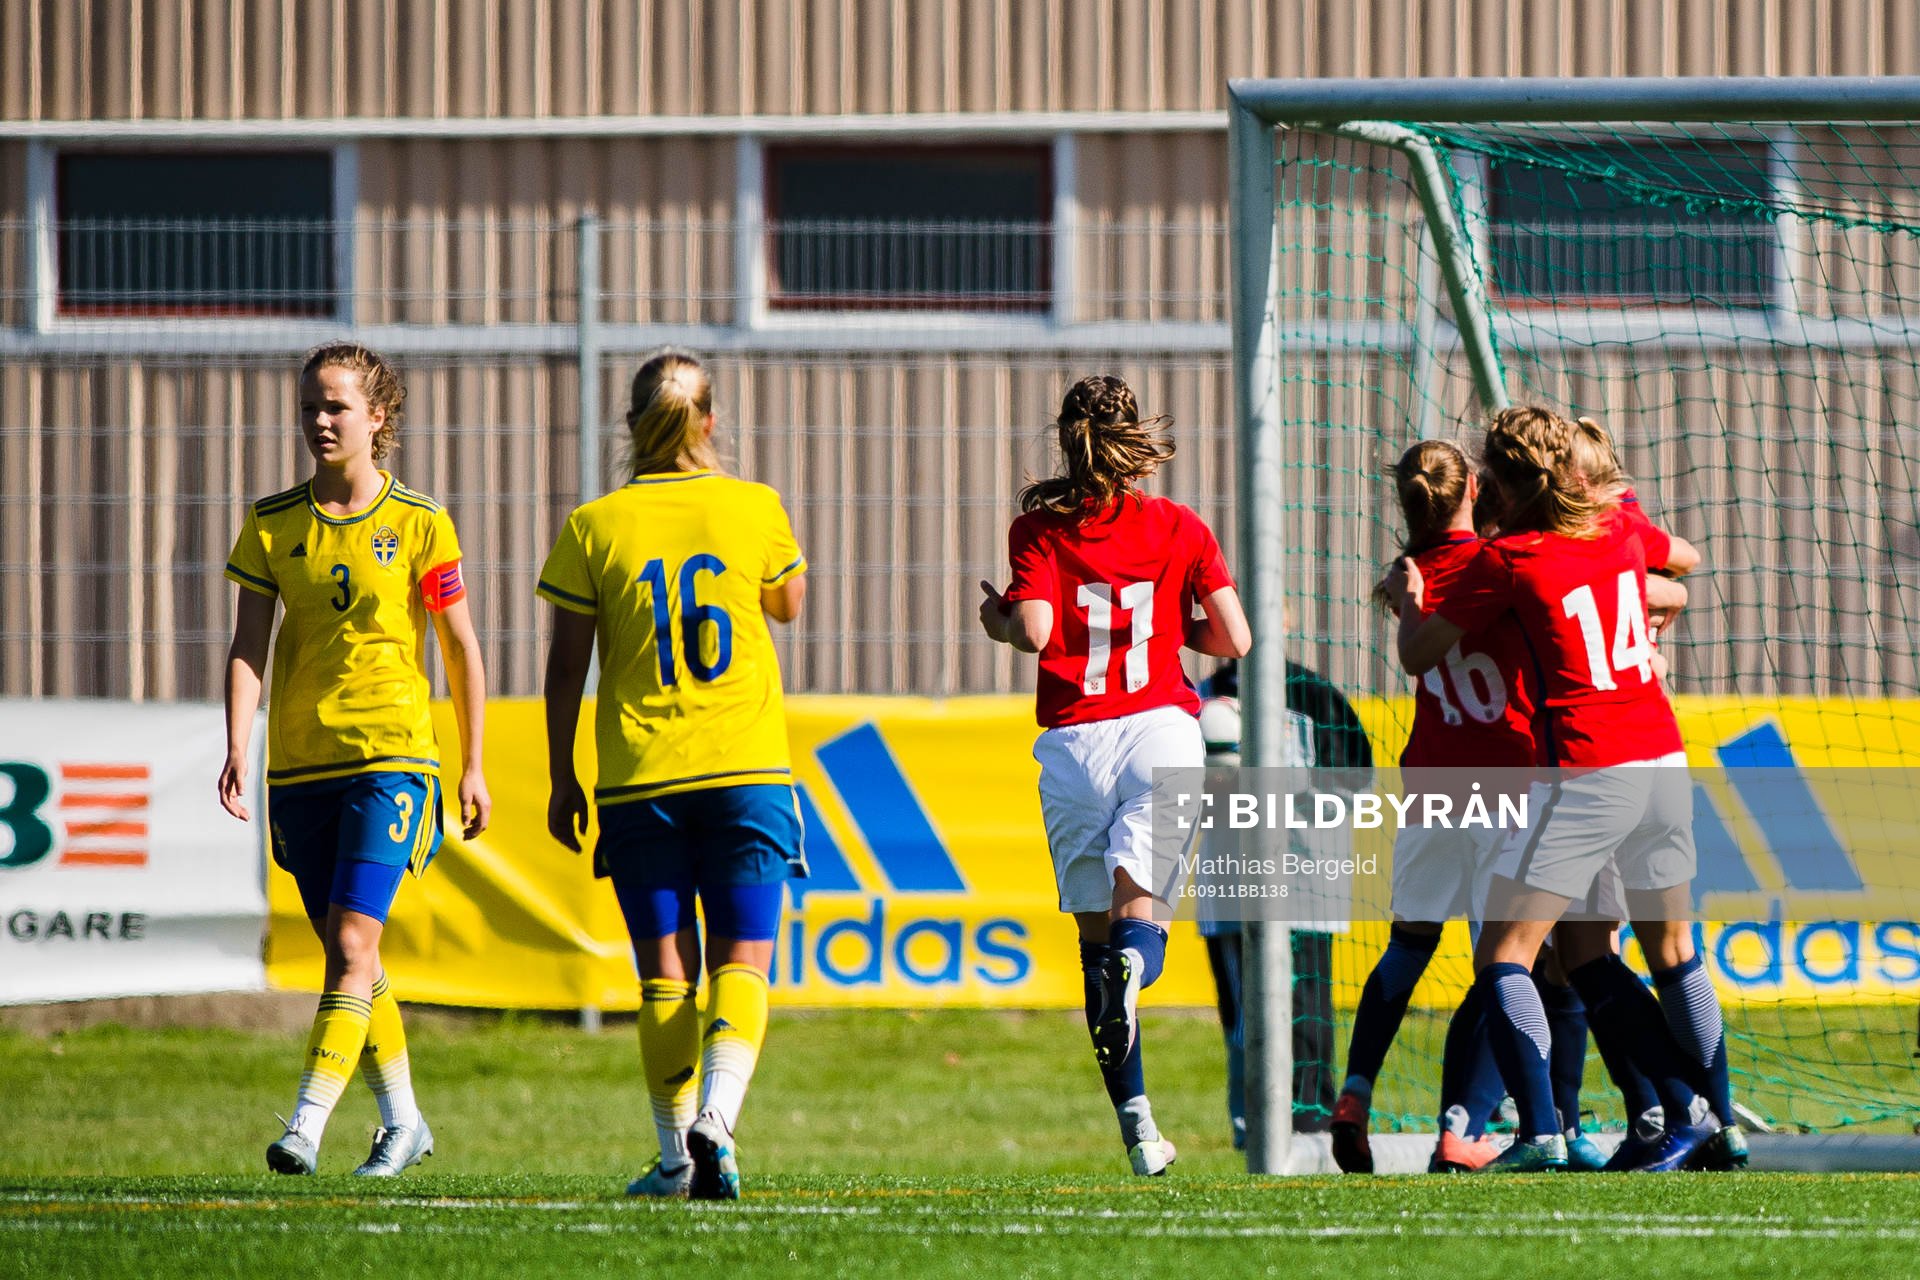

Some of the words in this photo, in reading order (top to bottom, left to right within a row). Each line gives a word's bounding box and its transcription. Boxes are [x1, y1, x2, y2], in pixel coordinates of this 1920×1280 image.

[330, 563, 351, 612] 3
[636, 553, 733, 686] 16
[1561, 569, 1653, 691] 14
[1077, 581, 1154, 695] 11
[388, 792, 414, 843] 3
[0, 910, 147, 941] GARE
[768, 896, 1031, 985] idas
